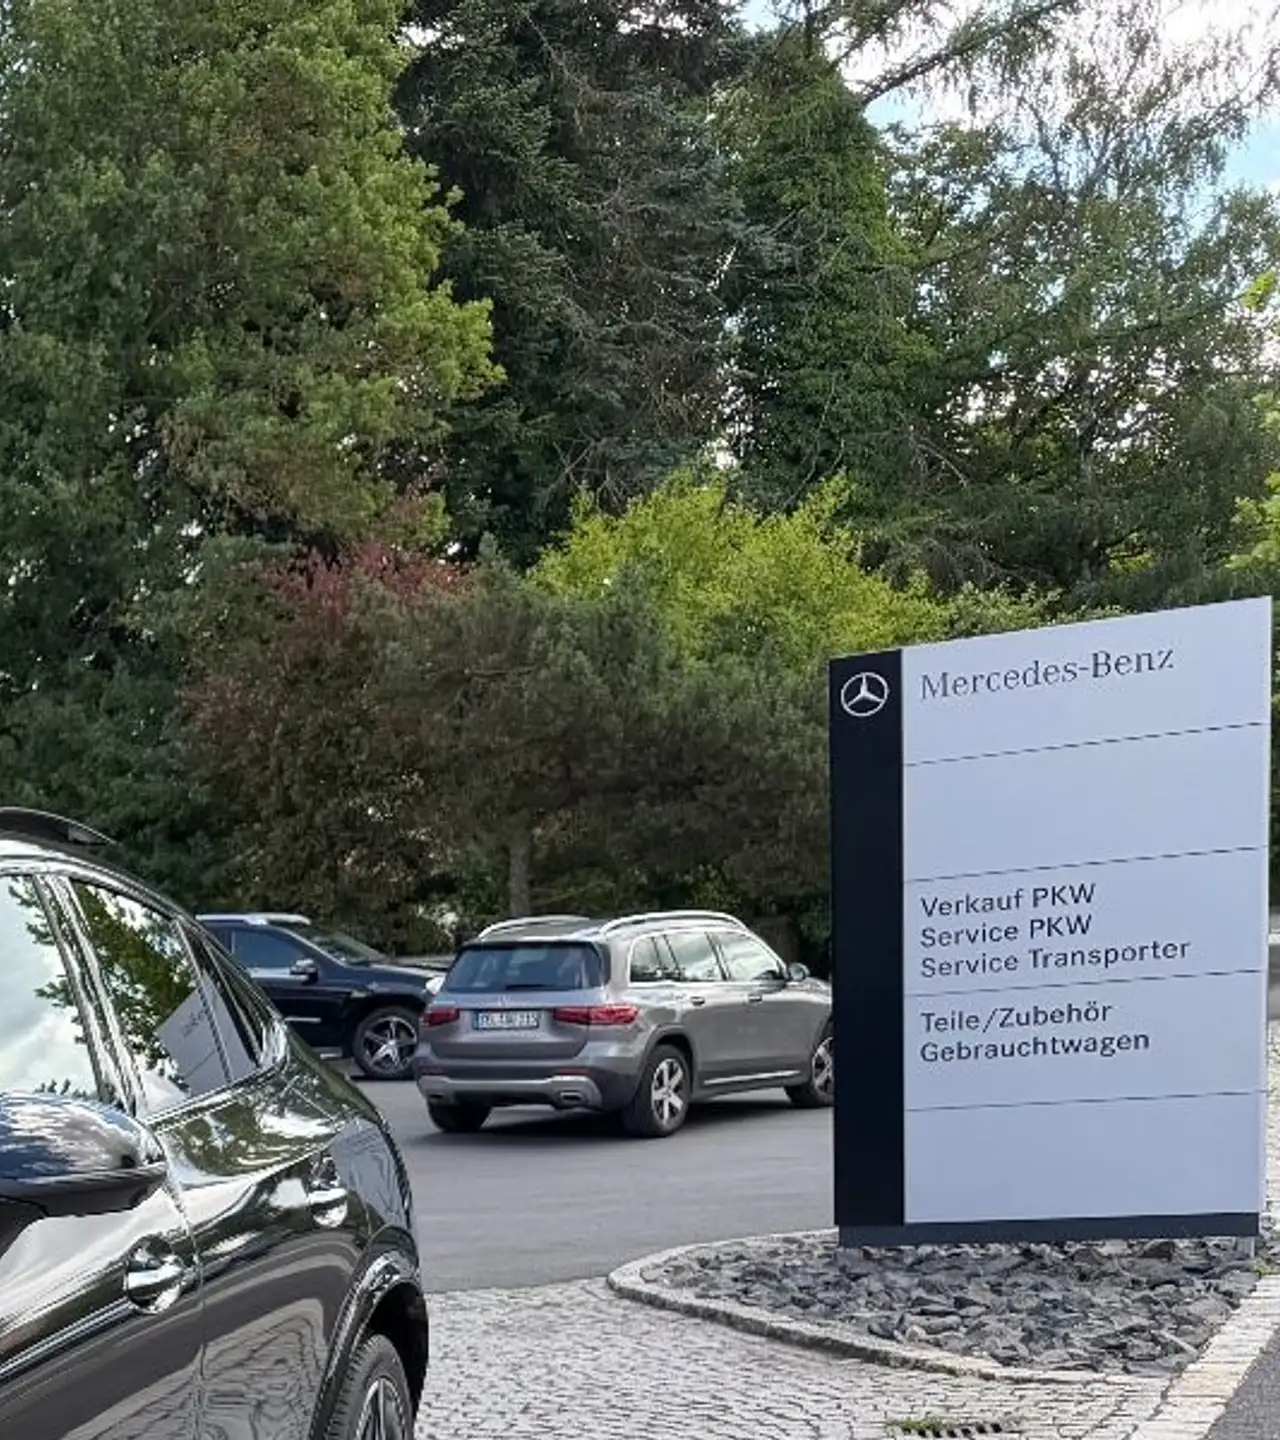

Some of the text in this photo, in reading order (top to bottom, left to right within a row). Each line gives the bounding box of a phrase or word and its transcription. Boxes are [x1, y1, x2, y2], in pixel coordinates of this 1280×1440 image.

[920, 649, 1174, 701] Mercedes-Benz
[920, 883, 1096, 918] Verkauf PKW
[919, 914, 1093, 949] Service PKW
[920, 939, 1191, 978] Service Transporter
[919, 1000, 1113, 1034] Teile/Zubehör
[919, 1033, 1151, 1063] Gebrauchtwagen
